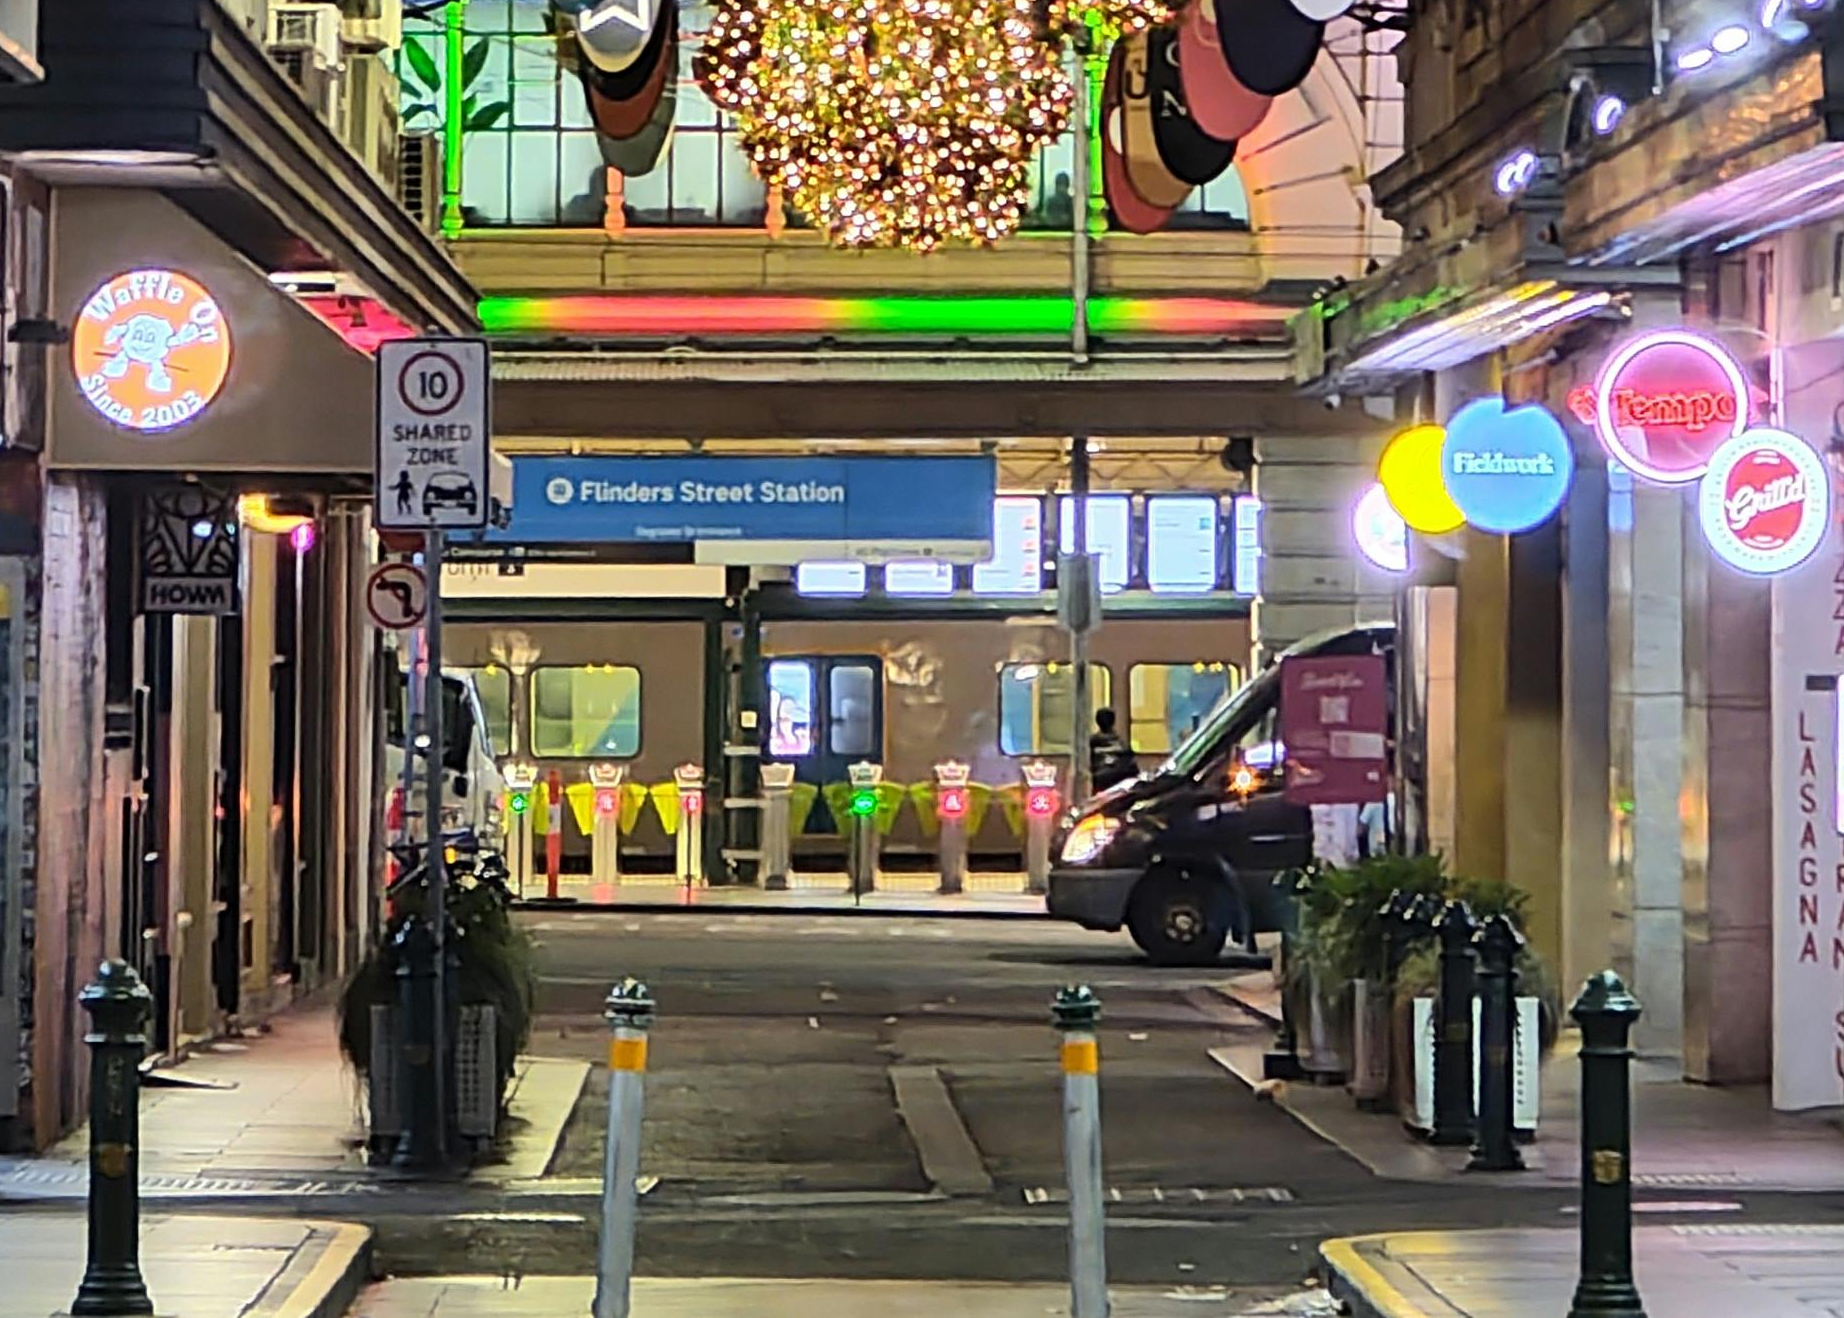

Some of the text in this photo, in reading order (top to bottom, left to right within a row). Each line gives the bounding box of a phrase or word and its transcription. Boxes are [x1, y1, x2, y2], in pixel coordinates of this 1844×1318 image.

[82, 274, 184, 320] Waffle
[419, 370, 448, 399] 10
[81, 374, 203, 428] Since 2003
[1615, 389, 1737, 432] Tempo
[393, 423, 472, 442] SHARED
[407, 447, 459, 466] ZONE
[1453, 451, 1554, 475] Fieldwork
[580, 480, 845, 503] Flinders Street Station
[1798, 711, 1819, 963] LASAGNA
